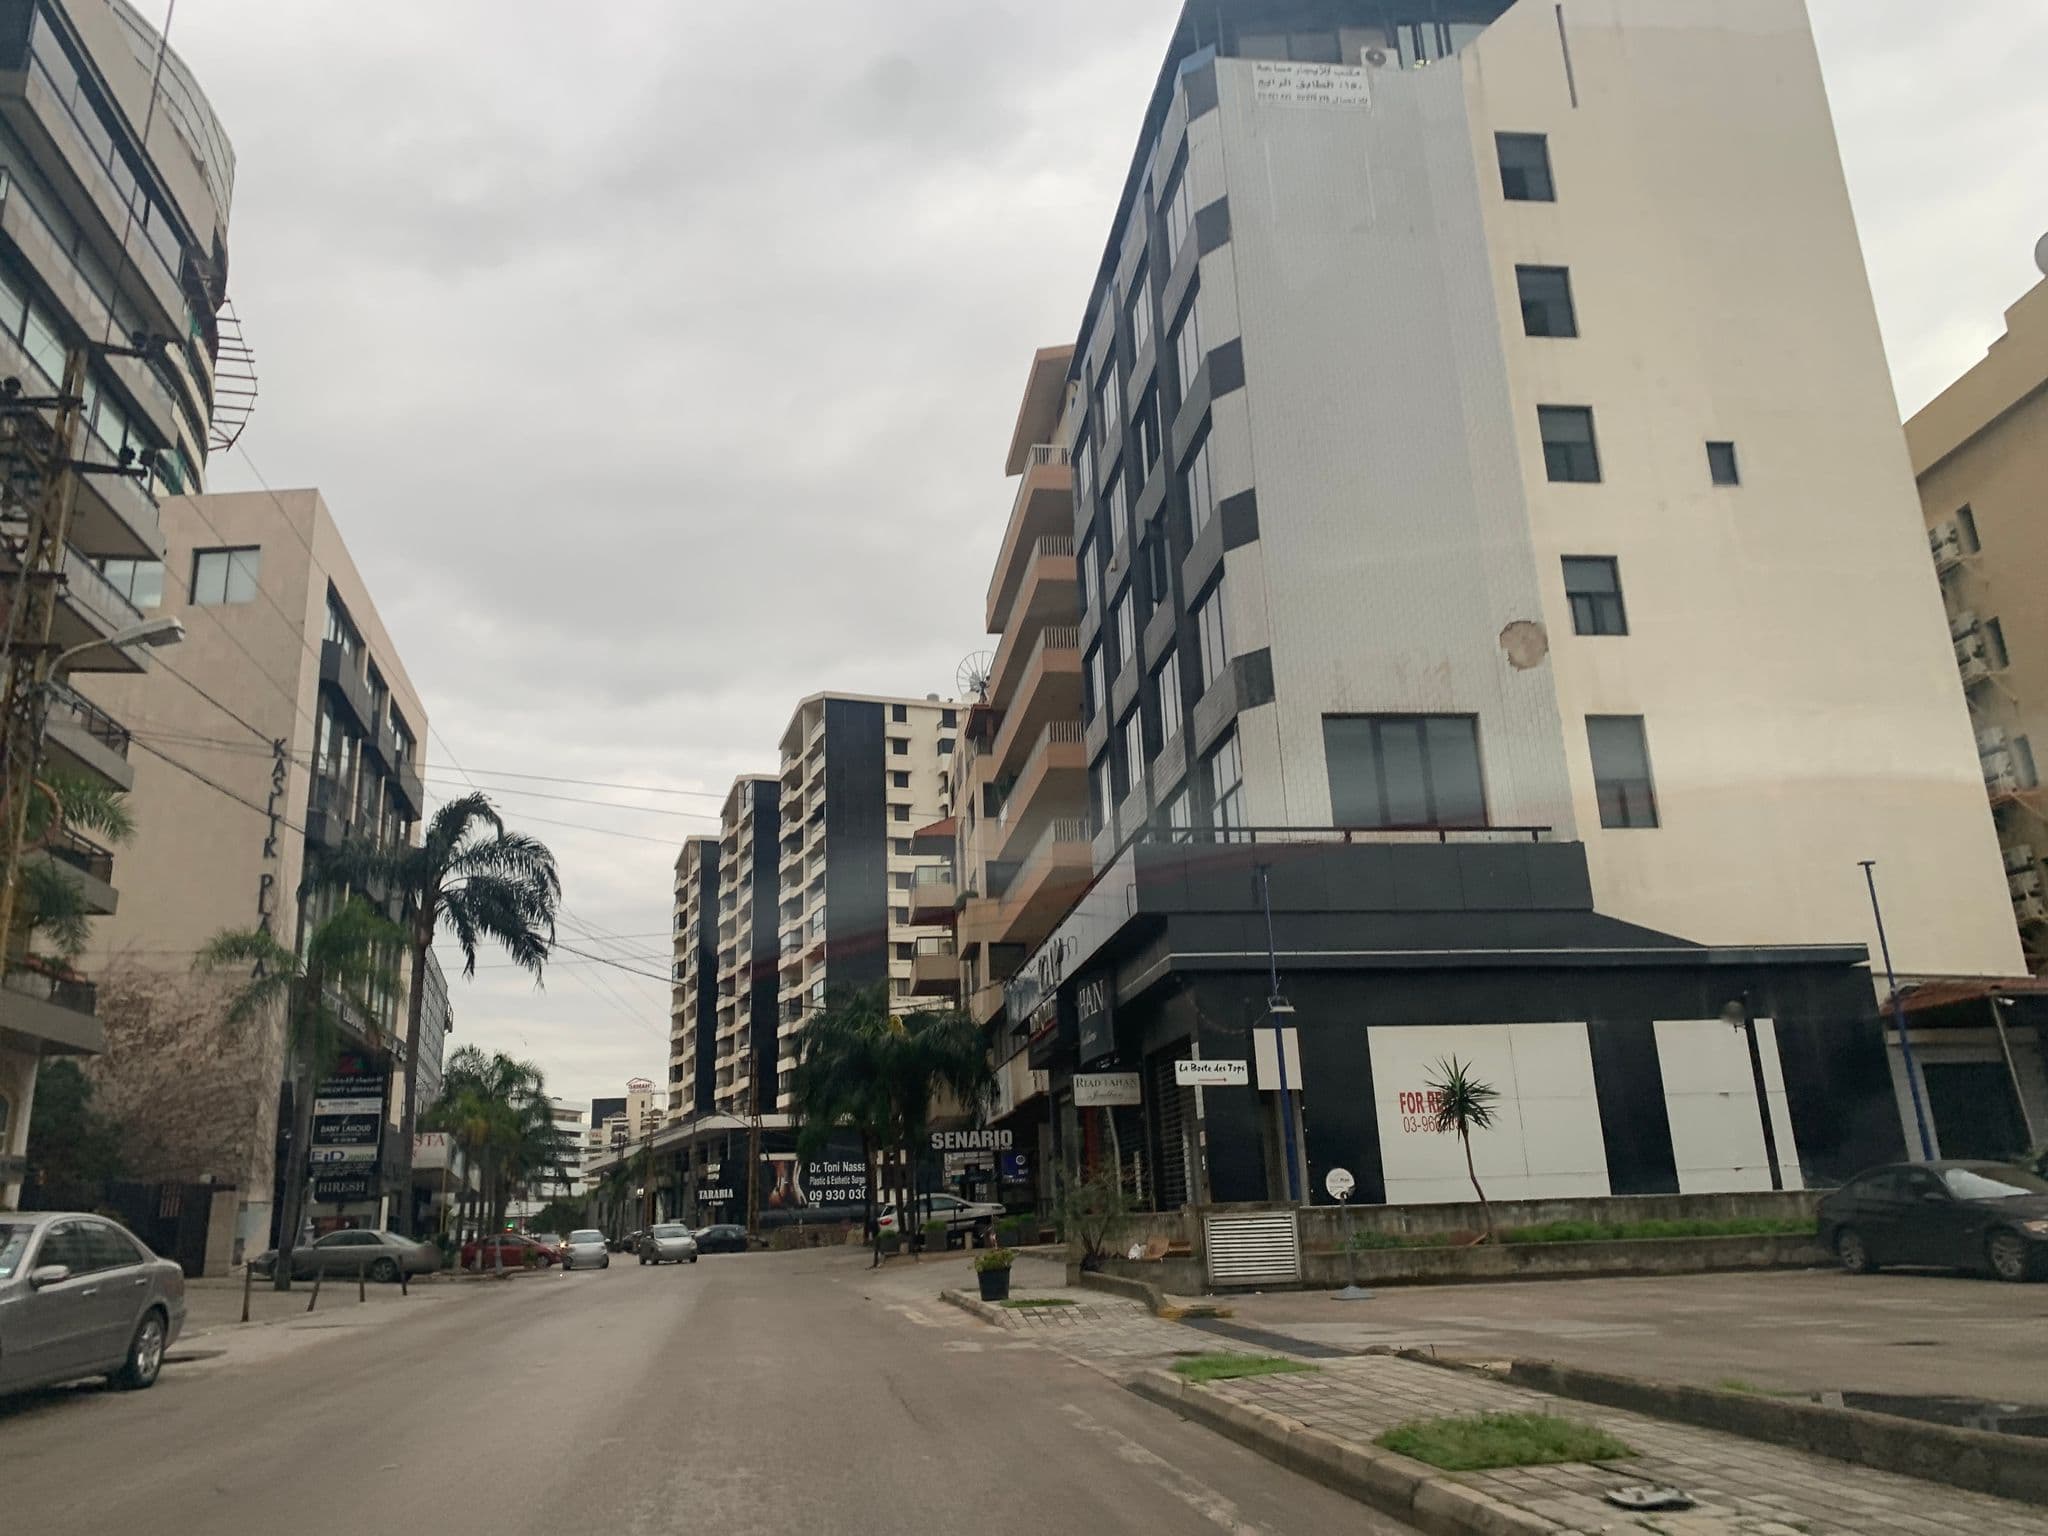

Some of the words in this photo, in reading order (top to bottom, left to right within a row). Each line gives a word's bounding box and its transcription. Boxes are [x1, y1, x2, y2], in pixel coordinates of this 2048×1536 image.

[251, 873, 274, 979] PLAA
[1179, 1063, 1188, 1072] La
[1214, 1063, 1226, 1072] des
[1227, 1063, 1245, 1074] Tops
[1399, 1091, 1425, 1114] FOR
[931, 1129, 1013, 1150] SENARIO
[809, 1162, 821, 1173] Dr.
[823, 1161, 840, 1173] Toni
[809, 1175, 826, 1186] Plastic
[809, 1190, 823, 1201] 09
[825, 1189, 846, 1201] 930
